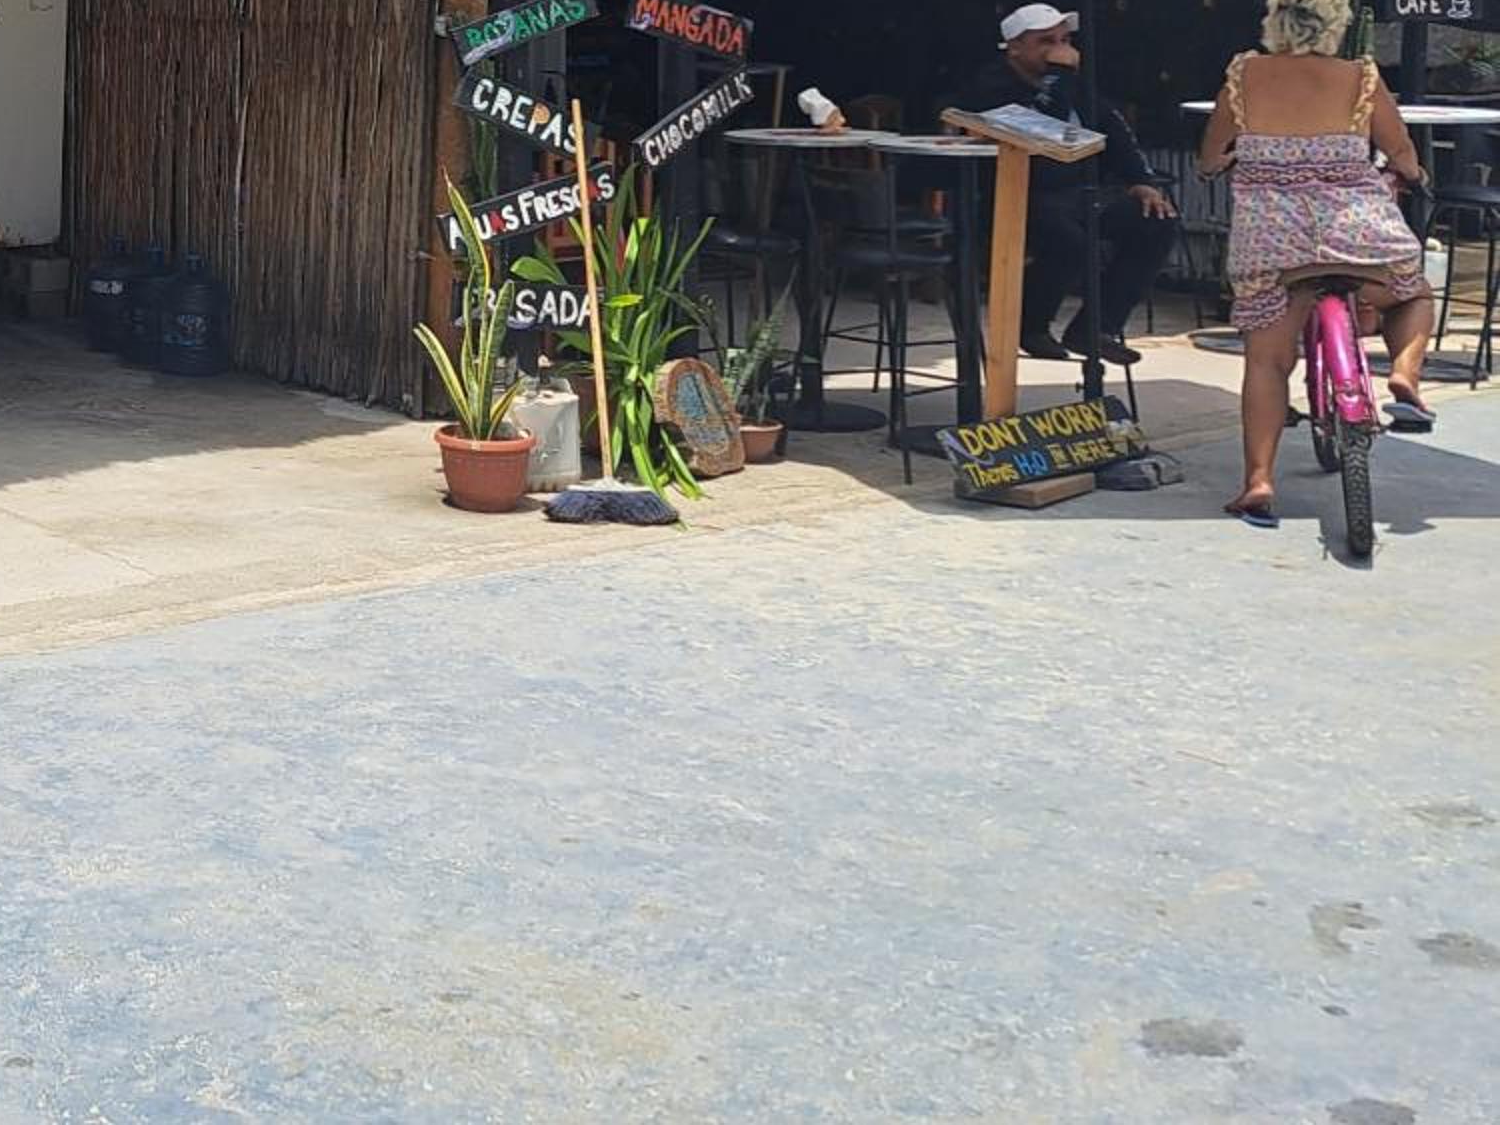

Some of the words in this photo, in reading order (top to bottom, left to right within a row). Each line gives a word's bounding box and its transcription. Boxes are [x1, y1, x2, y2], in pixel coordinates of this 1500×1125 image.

[471, 78, 586, 154] CREPAS
[644, 73, 754, 167] CHOCOMILK
[449, 201, 520, 250] AUAS
[1026, 400, 1109, 439] WORRY
